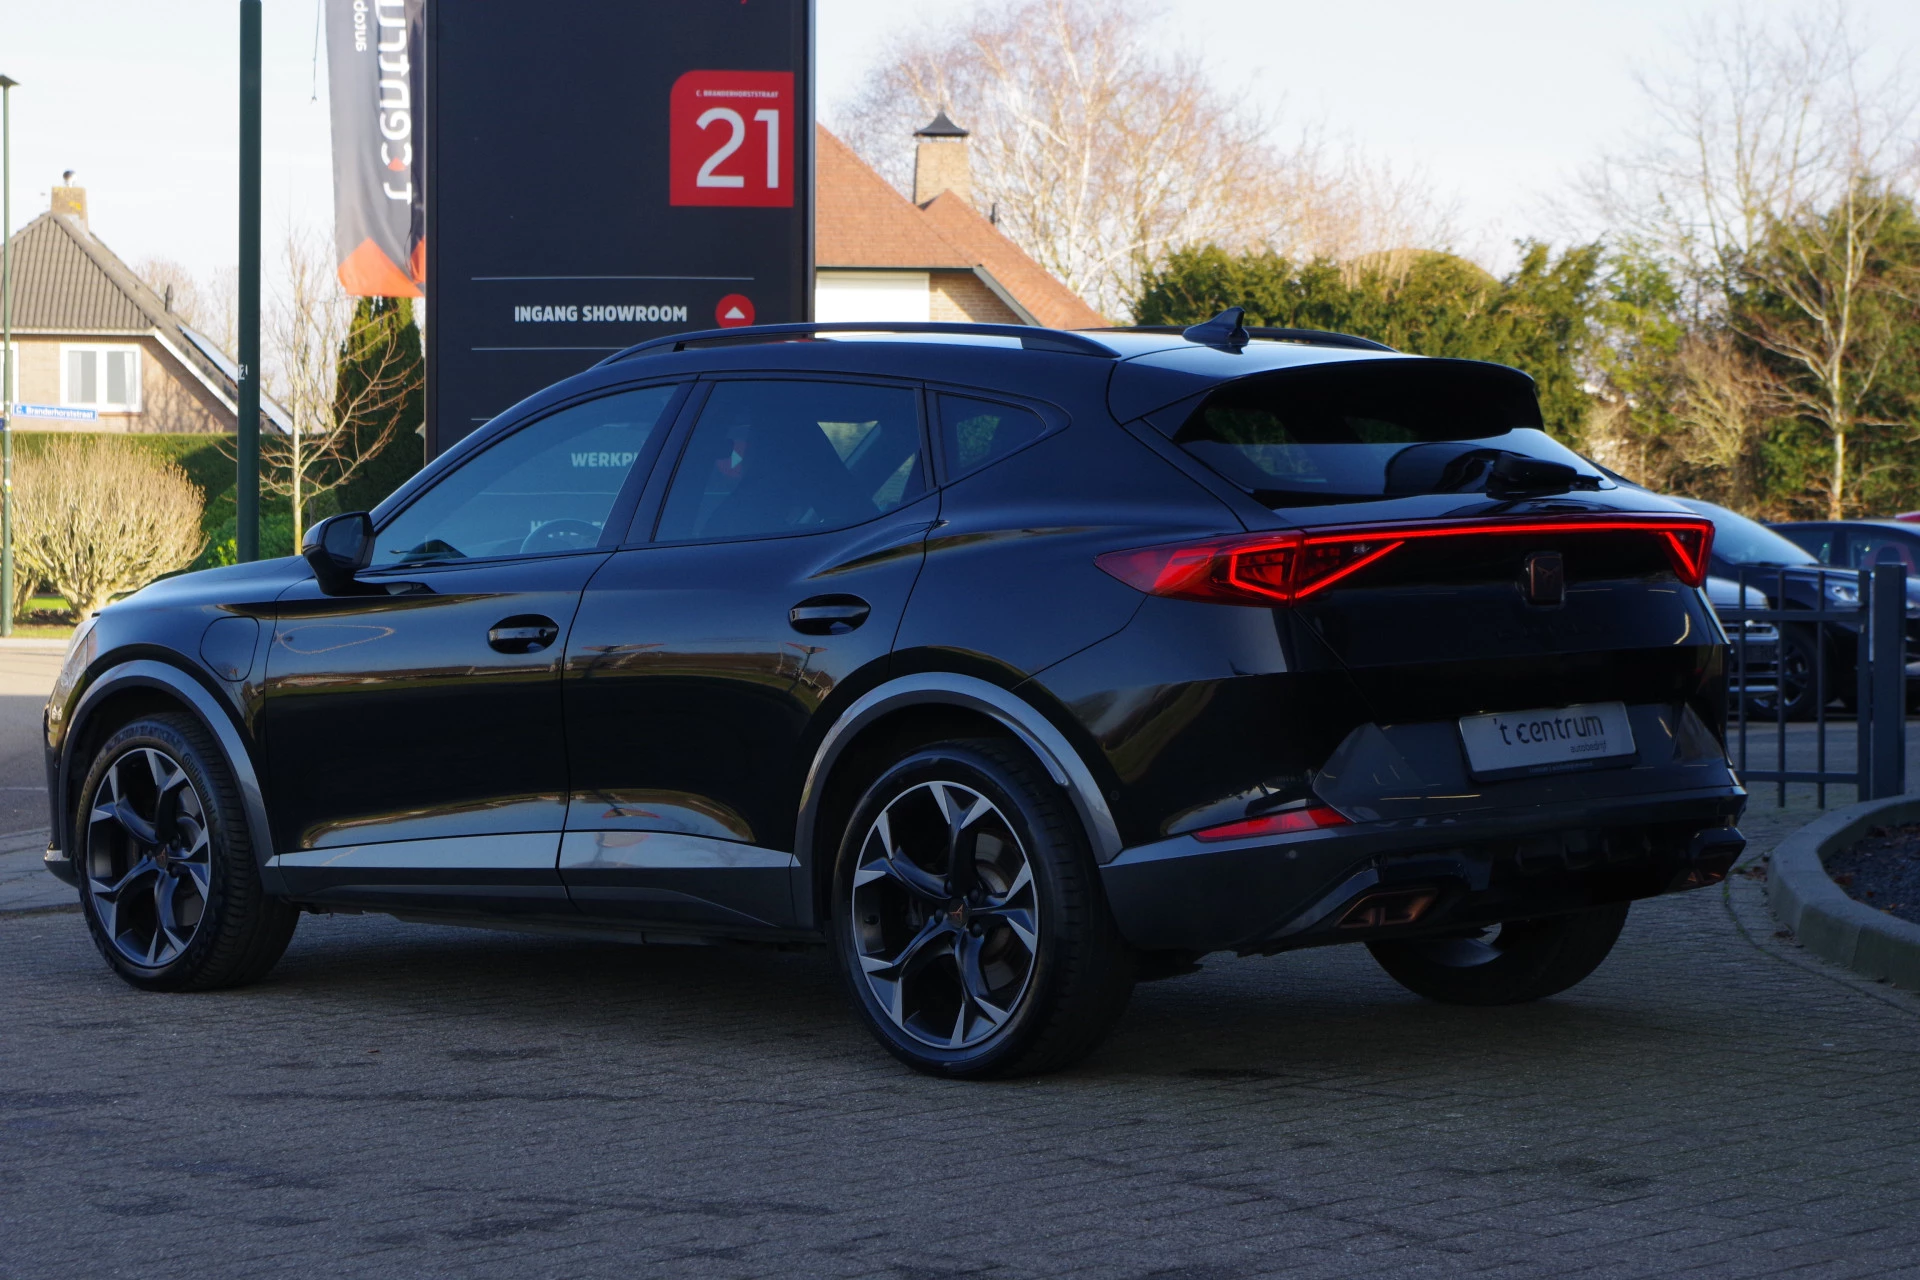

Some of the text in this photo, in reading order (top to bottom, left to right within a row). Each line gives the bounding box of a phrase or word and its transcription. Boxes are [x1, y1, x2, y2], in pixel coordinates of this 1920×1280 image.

[696, 107, 779, 189] 21
[514, 306, 687, 322] INGANG SHOWROOM
[1493, 716, 1604, 745] 't centrum
